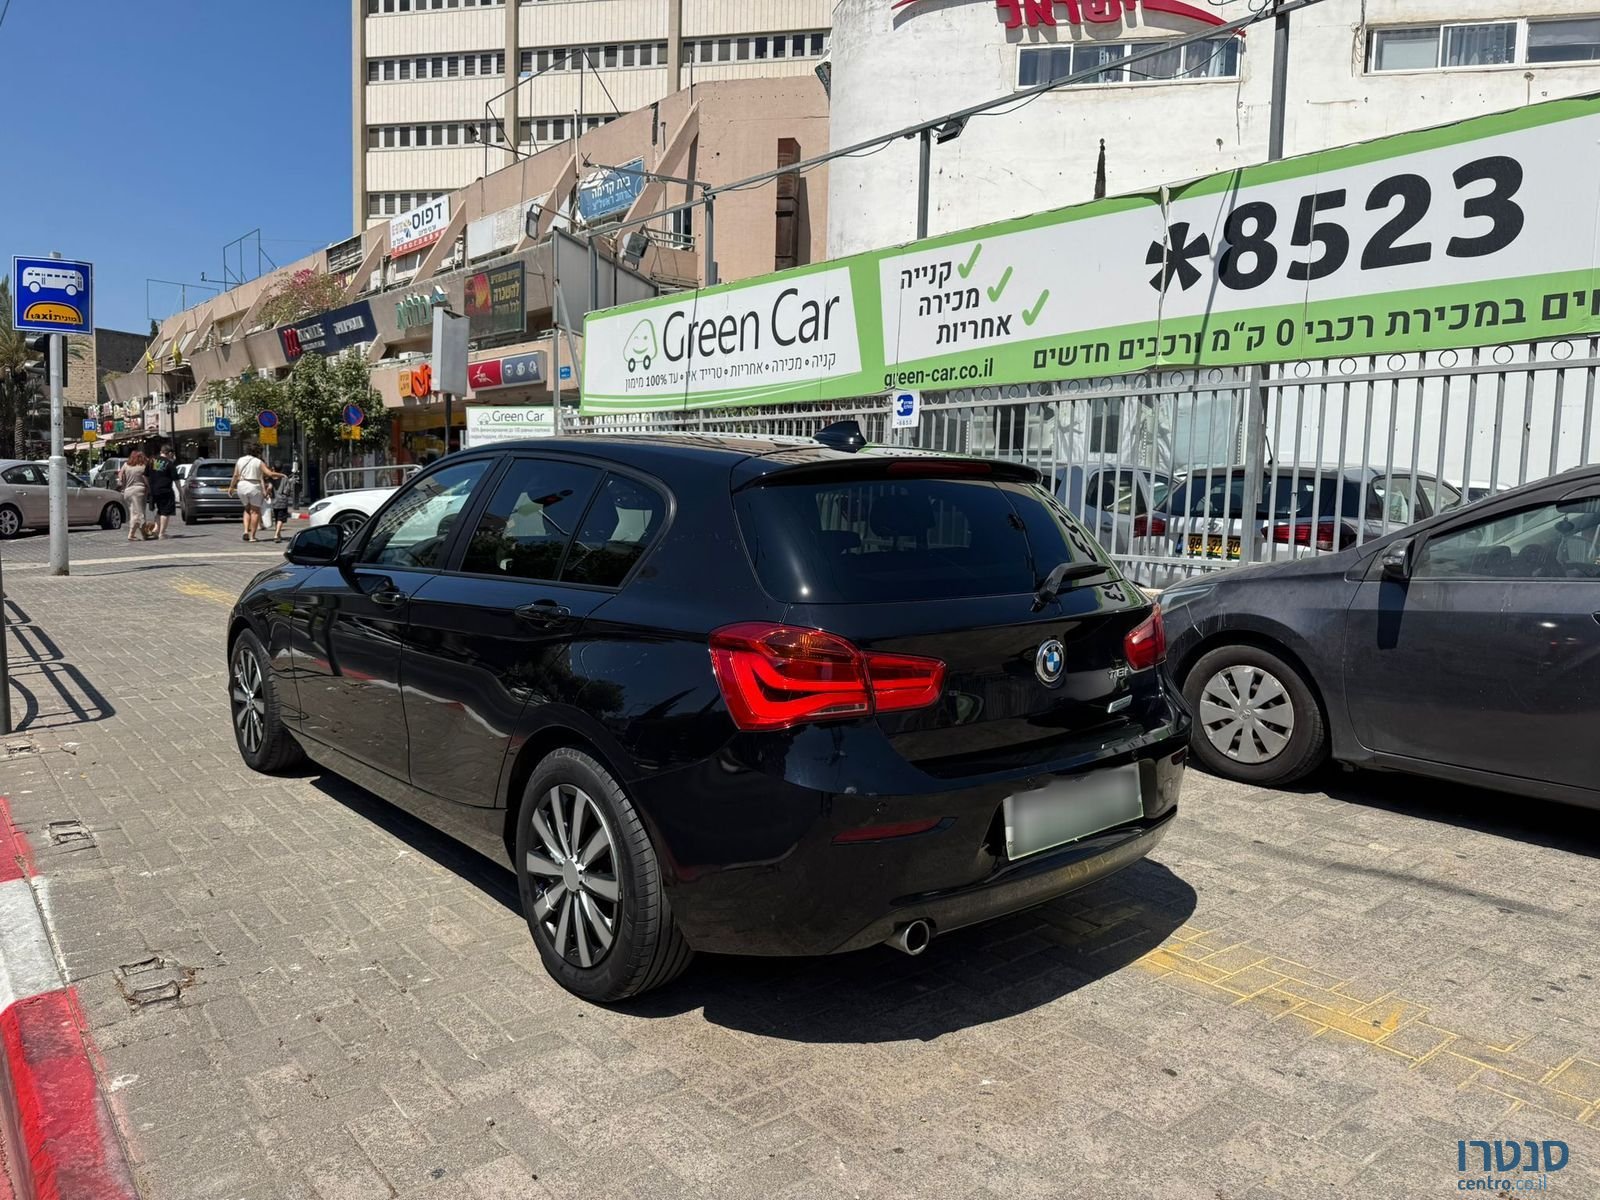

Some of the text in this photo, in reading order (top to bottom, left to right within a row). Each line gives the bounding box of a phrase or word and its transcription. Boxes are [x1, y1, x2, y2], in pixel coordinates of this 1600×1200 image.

[412, 202, 442, 230] דפוס
[900, 261, 952, 290] קנייה
[30, 309, 77, 322] taxi מונית
[919, 287, 980, 317] מכירה
[1541, 288, 1600, 321] ים
[662, 287, 840, 363] Green Car
[935, 314, 1013, 345] אחריות
[1305, 314, 1374, 343] רכבי
[1384, 298, 1526, 337] במכירת
[1118, 332, 1201, 361] ורכבים
[1276, 318, 1295, 347] 0
[729, 361, 763, 377] אחריות
[771, 356, 802, 373] מכירה
[811, 352, 837, 371] קניה
[1033, 342, 1110, 369] חדשים
[625, 376, 644, 392] מימון
[646, 373, 667, 386] 100%
[668, 372, 679, 385] עד
[699, 366, 722, 380] טרייד
[884, 358, 993, 390] green-car.co.il
[492, 410, 545, 422] Green Car
